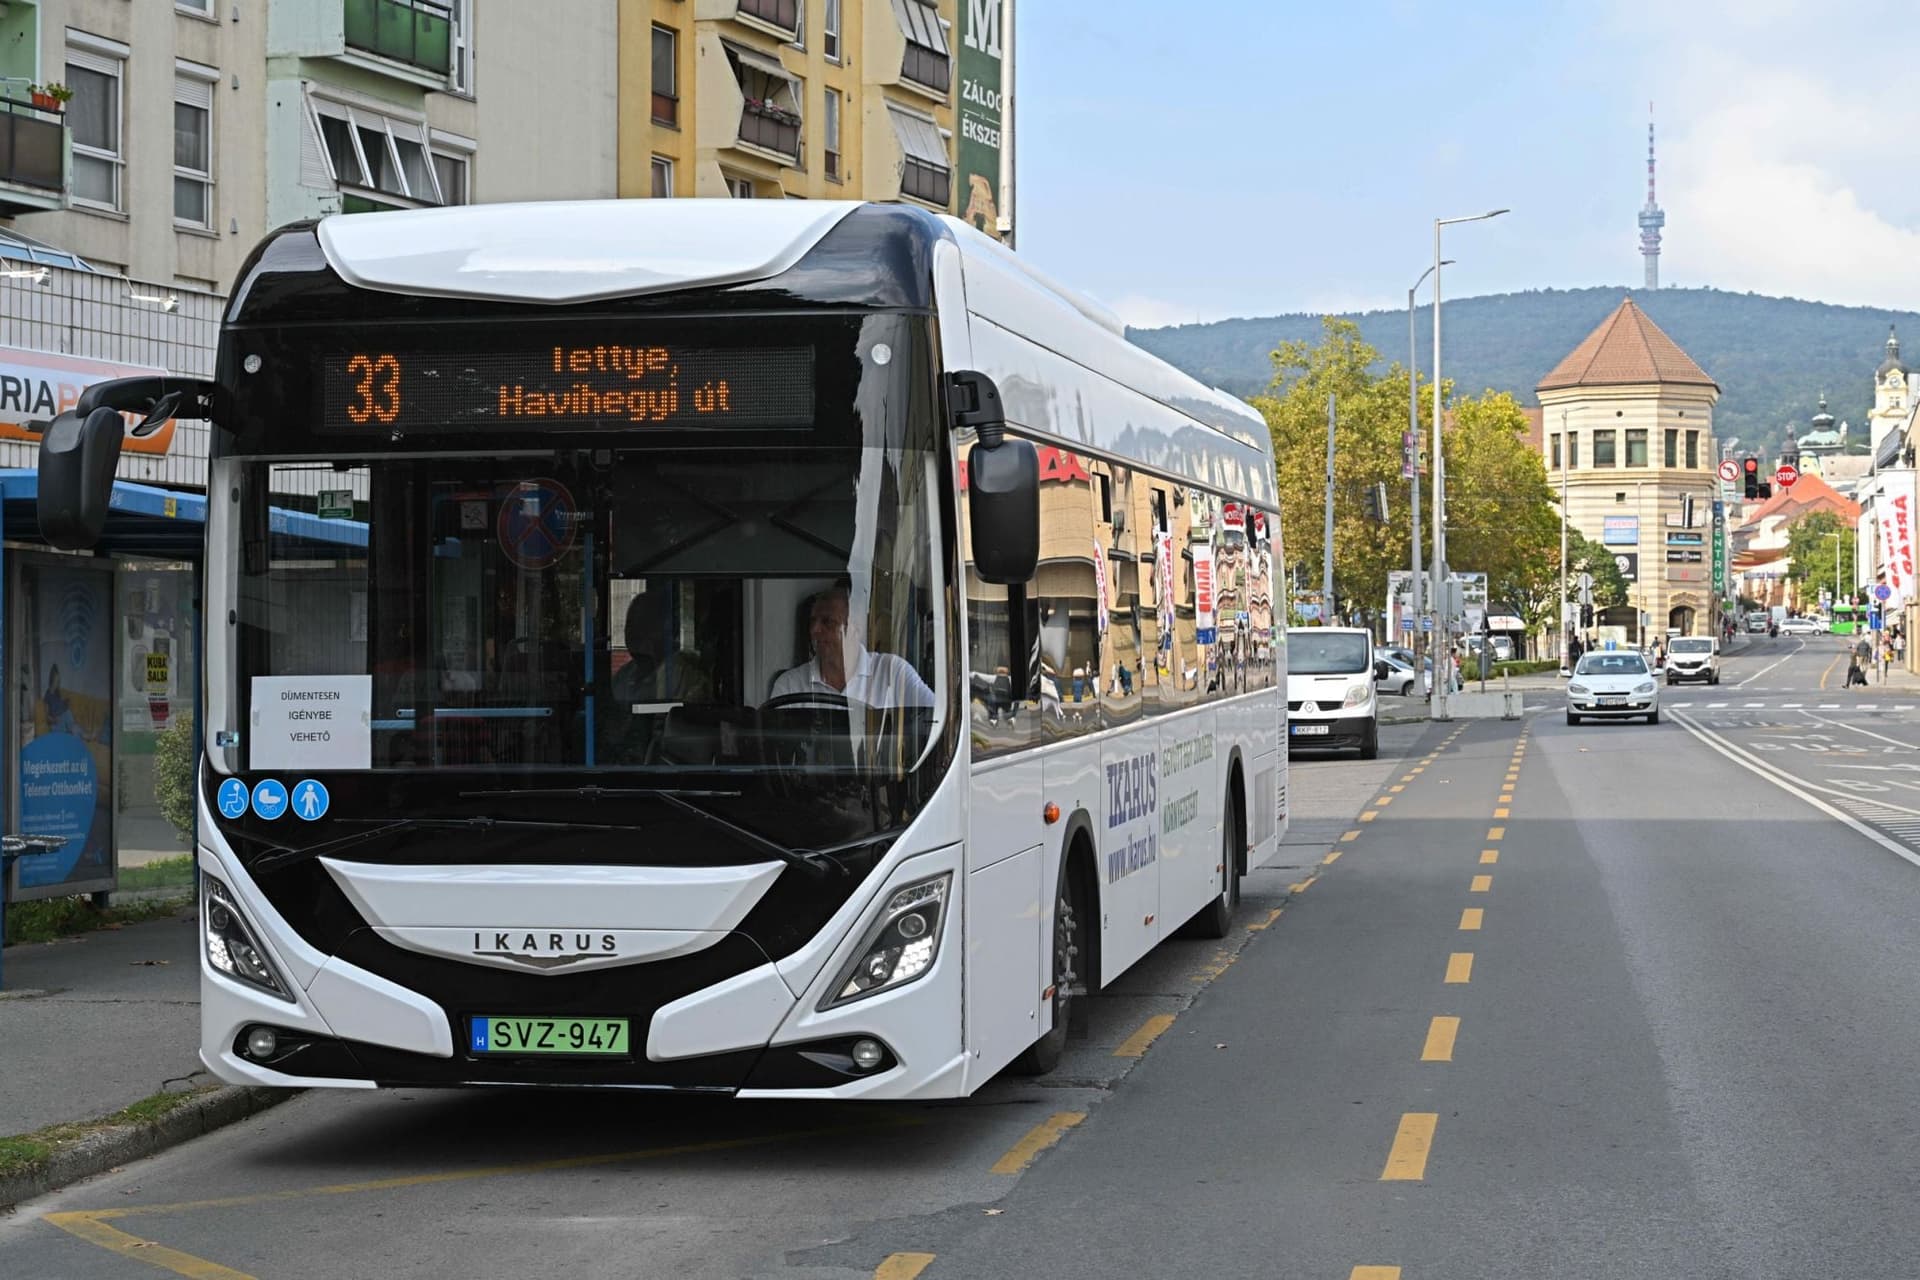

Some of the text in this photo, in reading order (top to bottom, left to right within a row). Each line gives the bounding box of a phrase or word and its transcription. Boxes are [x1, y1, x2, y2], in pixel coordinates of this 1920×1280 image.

[347, 354, 400, 424] 33
[499, 380, 730, 421] Havihegyi út
[1777, 472, 1796, 481] STOP
[1713, 517, 1724, 590] CENTRUM
[288, 709, 332, 720] IGÉNYBE
[24, 781, 92, 797] Telenor OtthonNet
[1106, 752, 1156, 829] IKARUS
[1108, 824, 1156, 885] www.ikarus.hu
[474, 932, 616, 951] IKARUS
[476, 1021, 622, 1050] H SVZ-947
